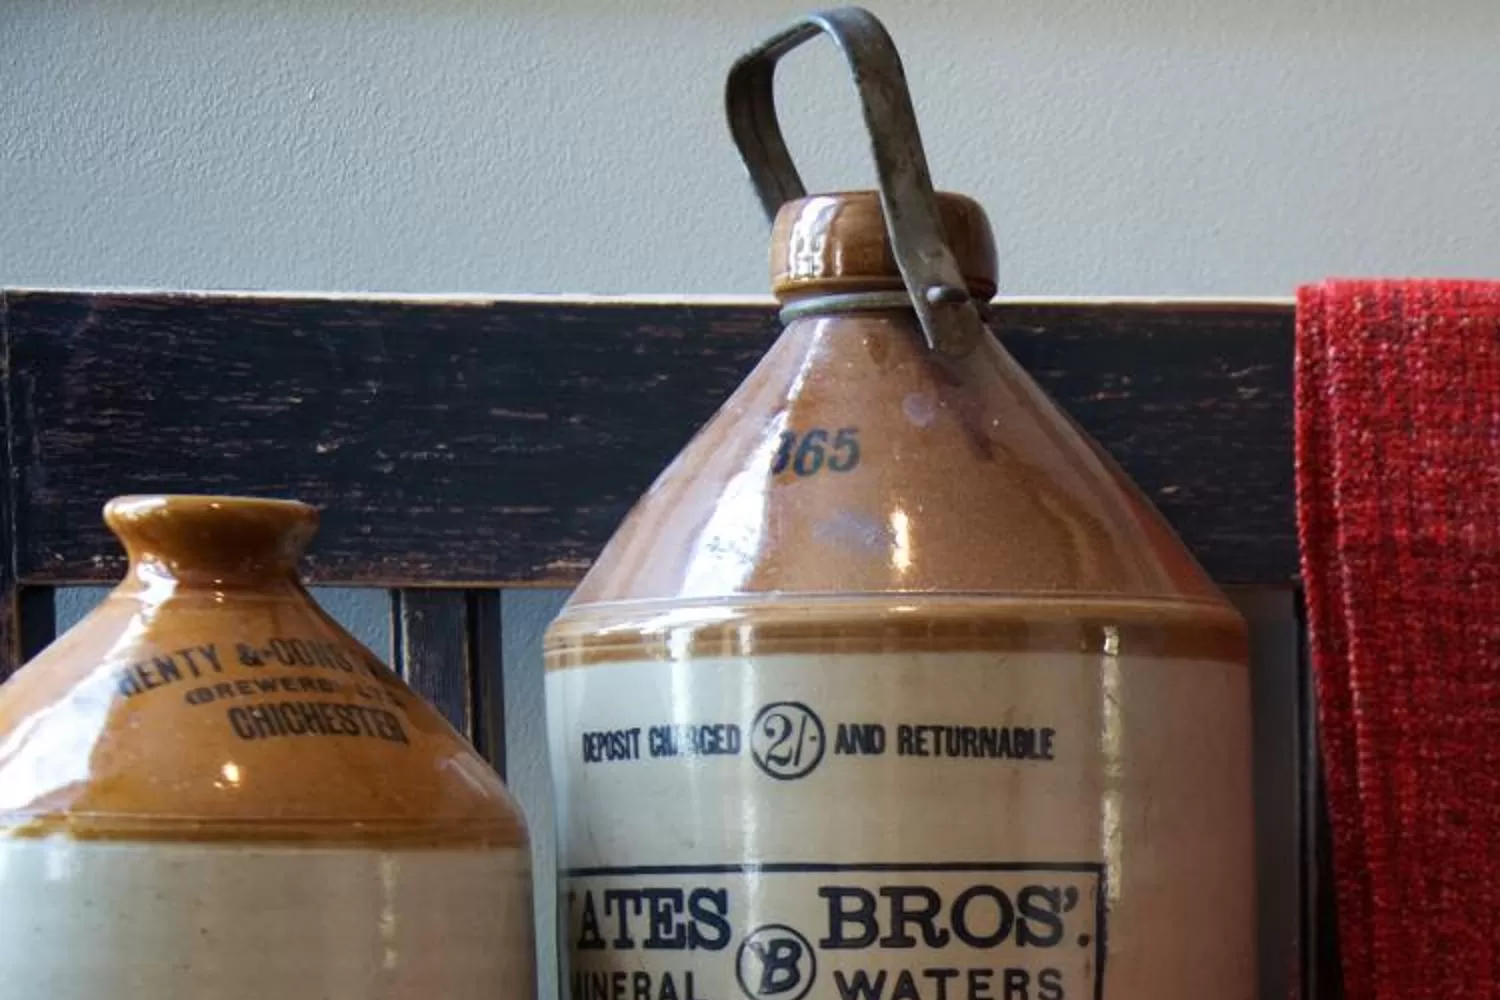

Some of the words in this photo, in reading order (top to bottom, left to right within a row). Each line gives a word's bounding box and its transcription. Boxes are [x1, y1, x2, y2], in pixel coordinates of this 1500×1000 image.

[226, 700, 410, 746] CHICHESTER
[582, 727, 642, 764] DEPOSIT
[647, 723, 743, 758] CHRGED
[834, 724, 886, 756] AND
[896, 724, 1056, 761] RETURNABLE
[569, 885, 733, 951] ATES
